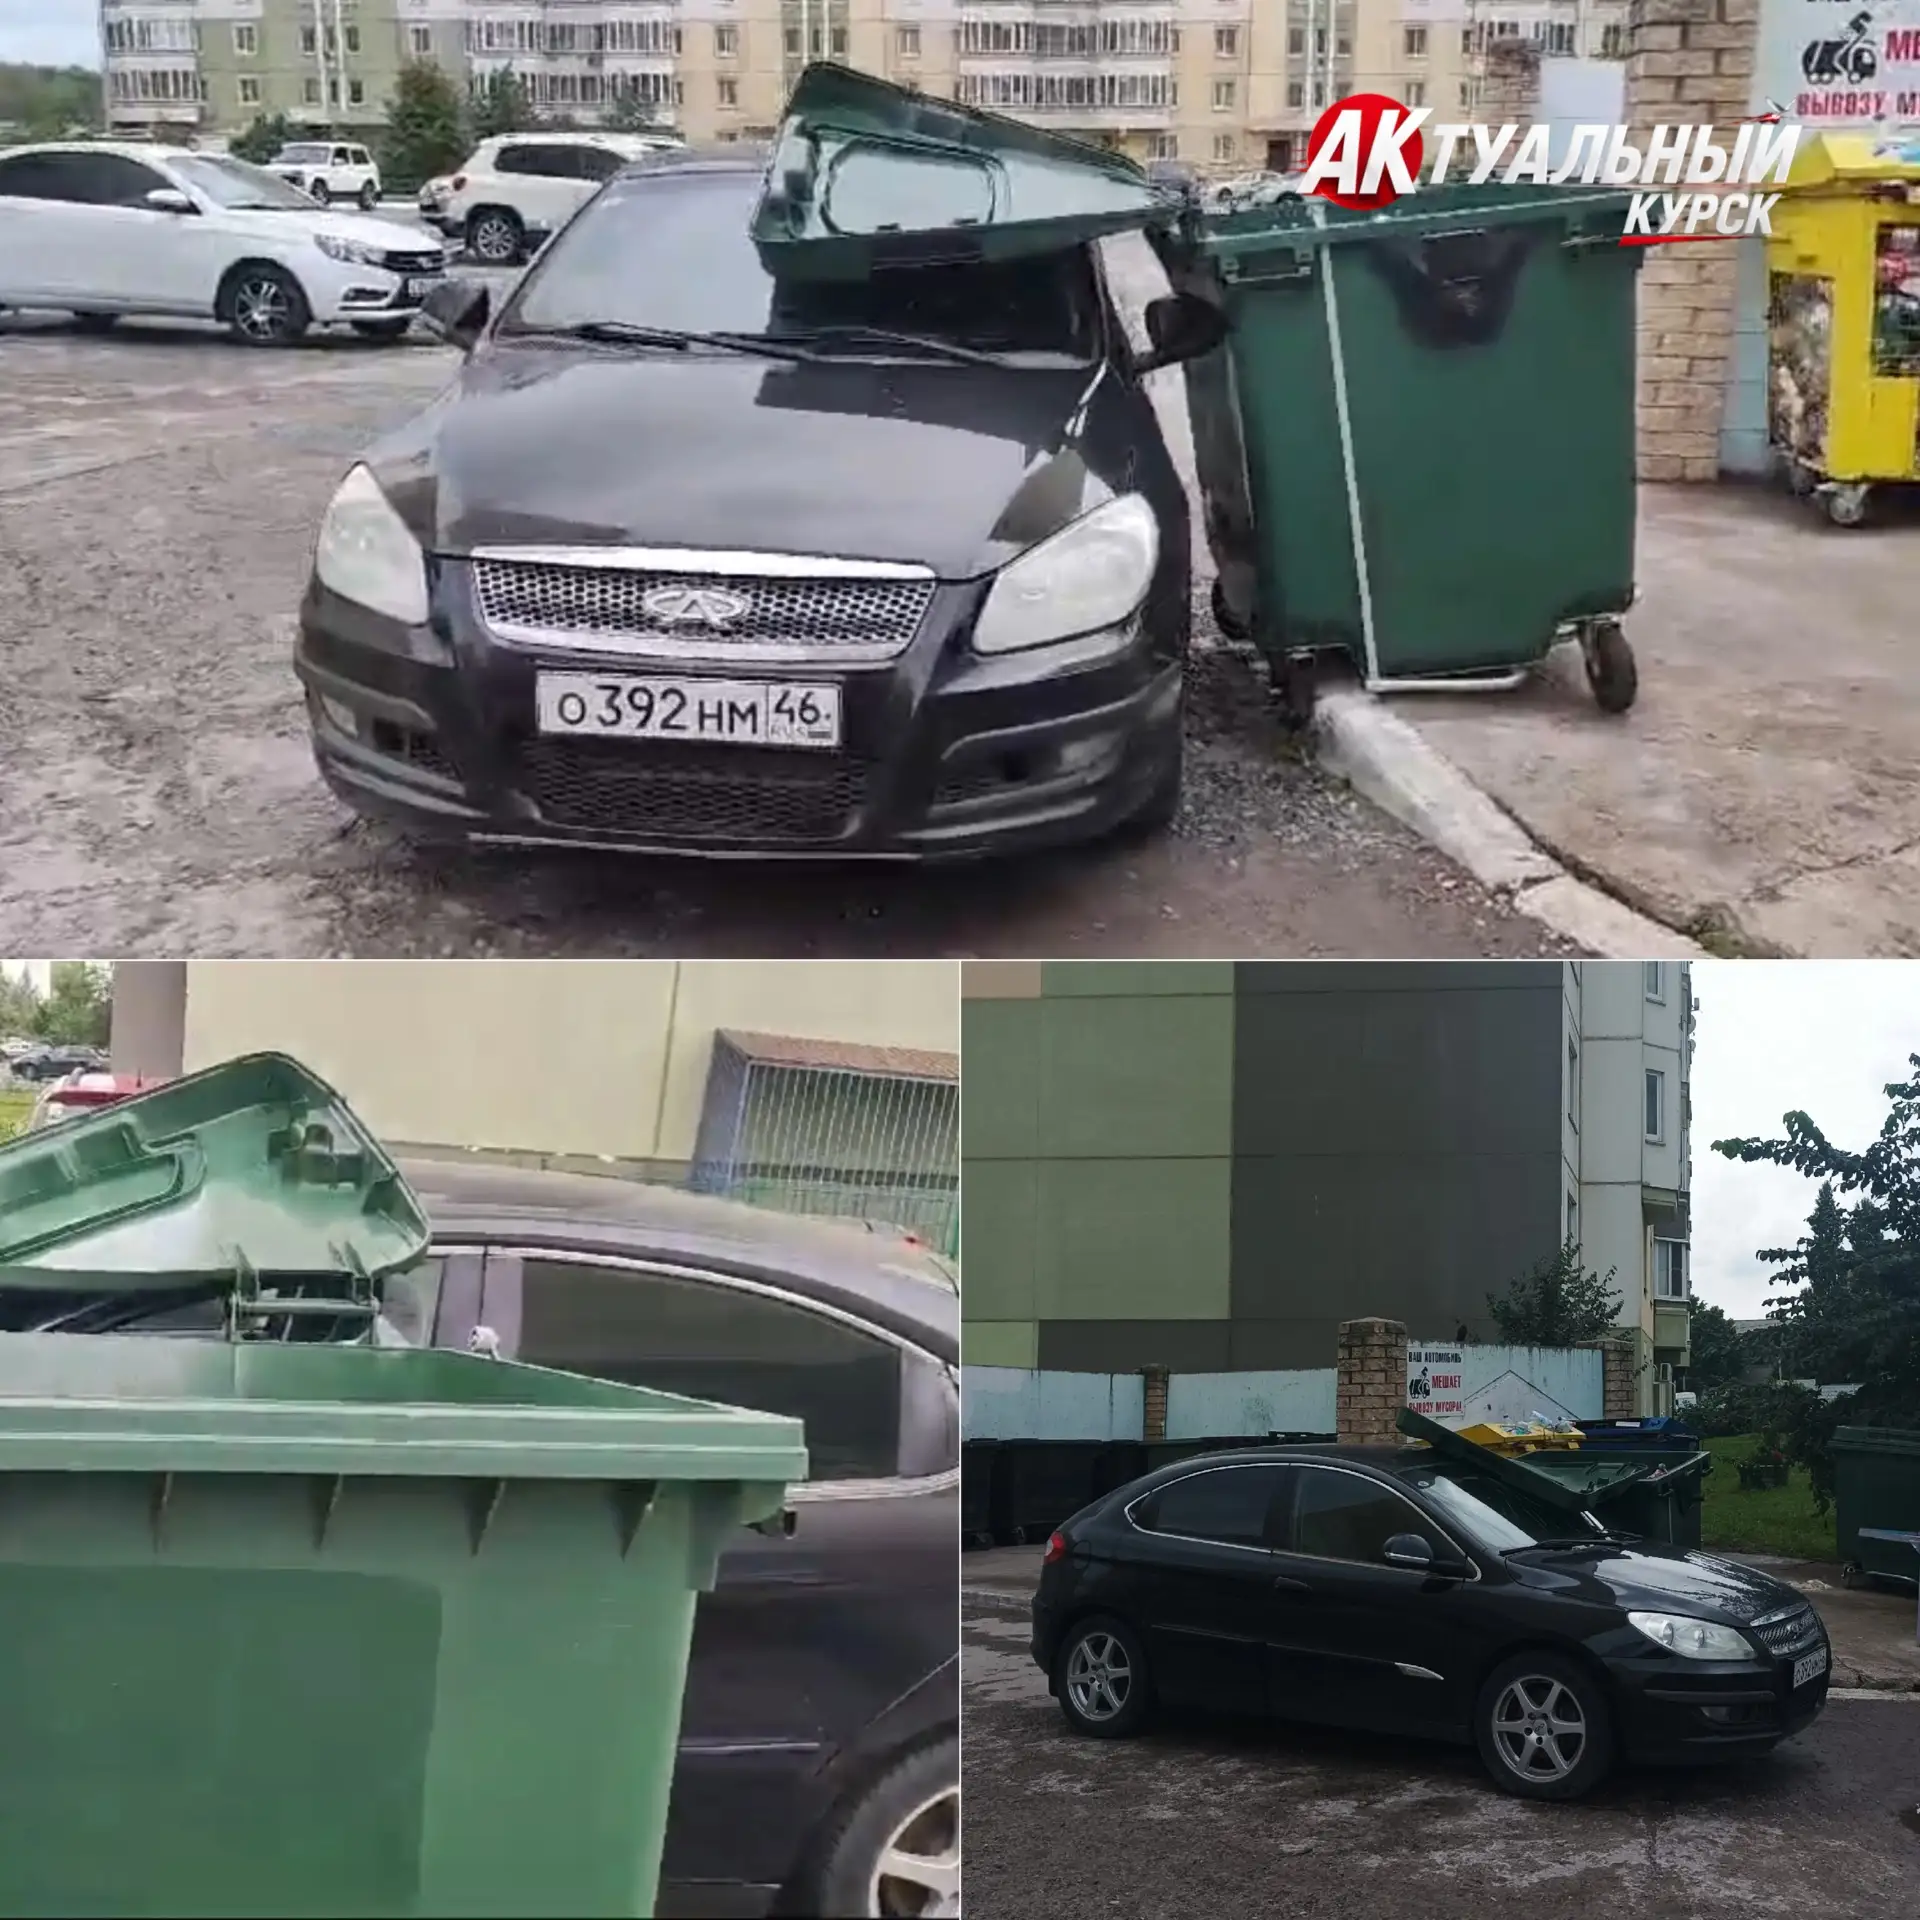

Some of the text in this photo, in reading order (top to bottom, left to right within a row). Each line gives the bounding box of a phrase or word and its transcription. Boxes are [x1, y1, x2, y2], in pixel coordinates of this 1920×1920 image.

[1797, 91, 1886, 116] ВЫВОЗУ
[1409, 1352, 1422, 1362] ВАШ
[1431, 1375, 1462, 1388] МЕШАЕТ
